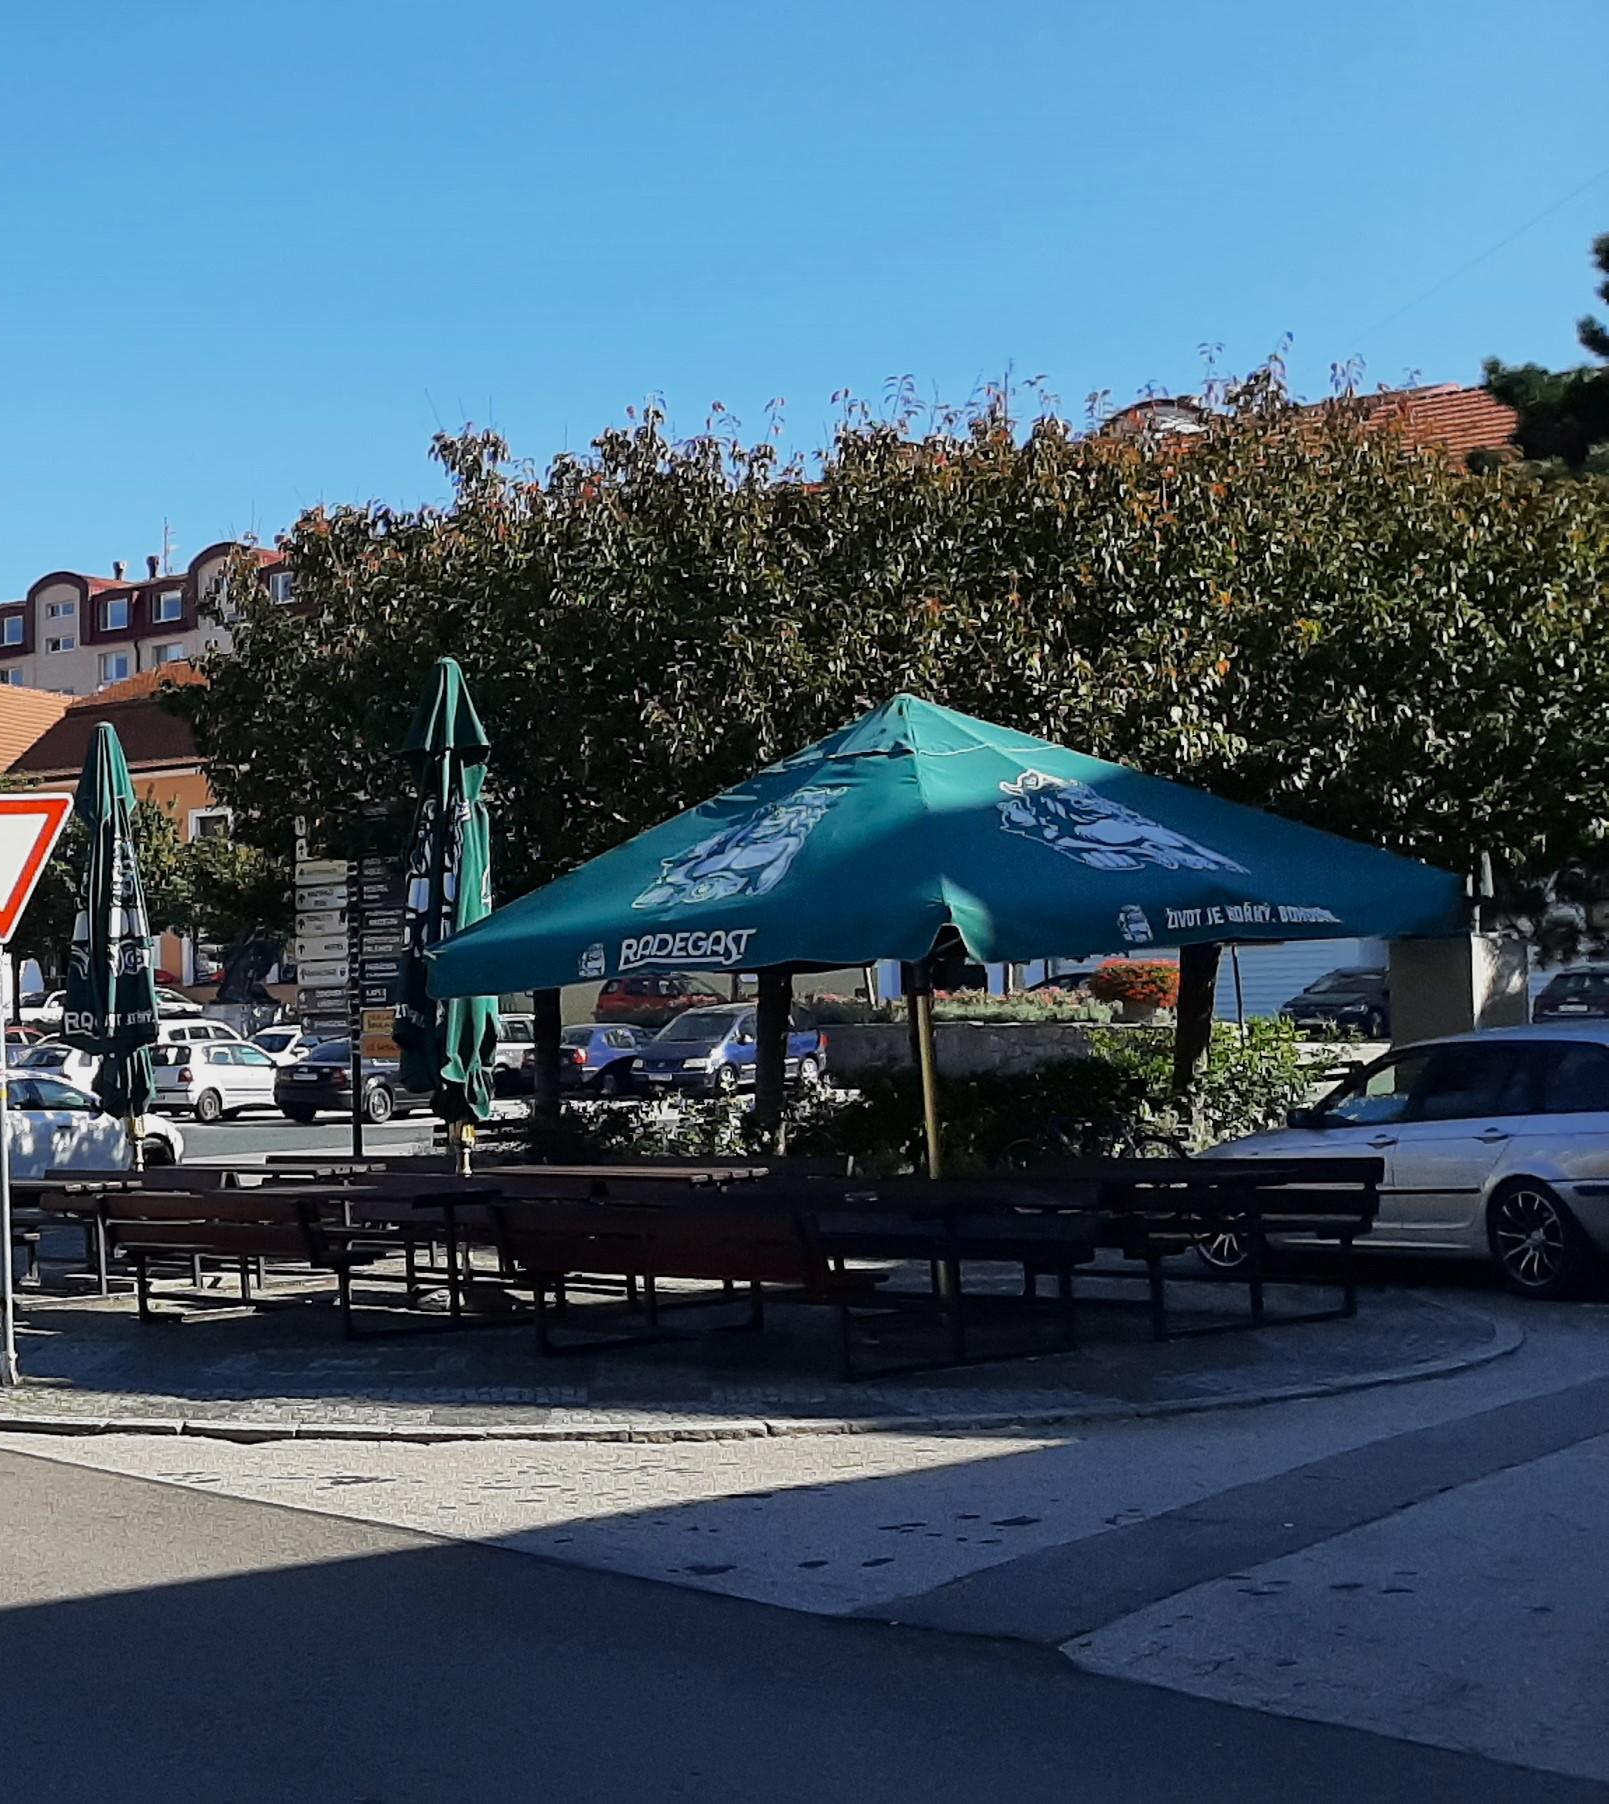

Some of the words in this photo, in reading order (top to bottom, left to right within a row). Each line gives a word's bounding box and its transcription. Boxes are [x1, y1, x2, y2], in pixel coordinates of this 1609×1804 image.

[1166, 907, 1202, 929] ŽIVOT
[1206, 906, 1224, 925] JE
[618, 927, 758, 971] RADEGAST
